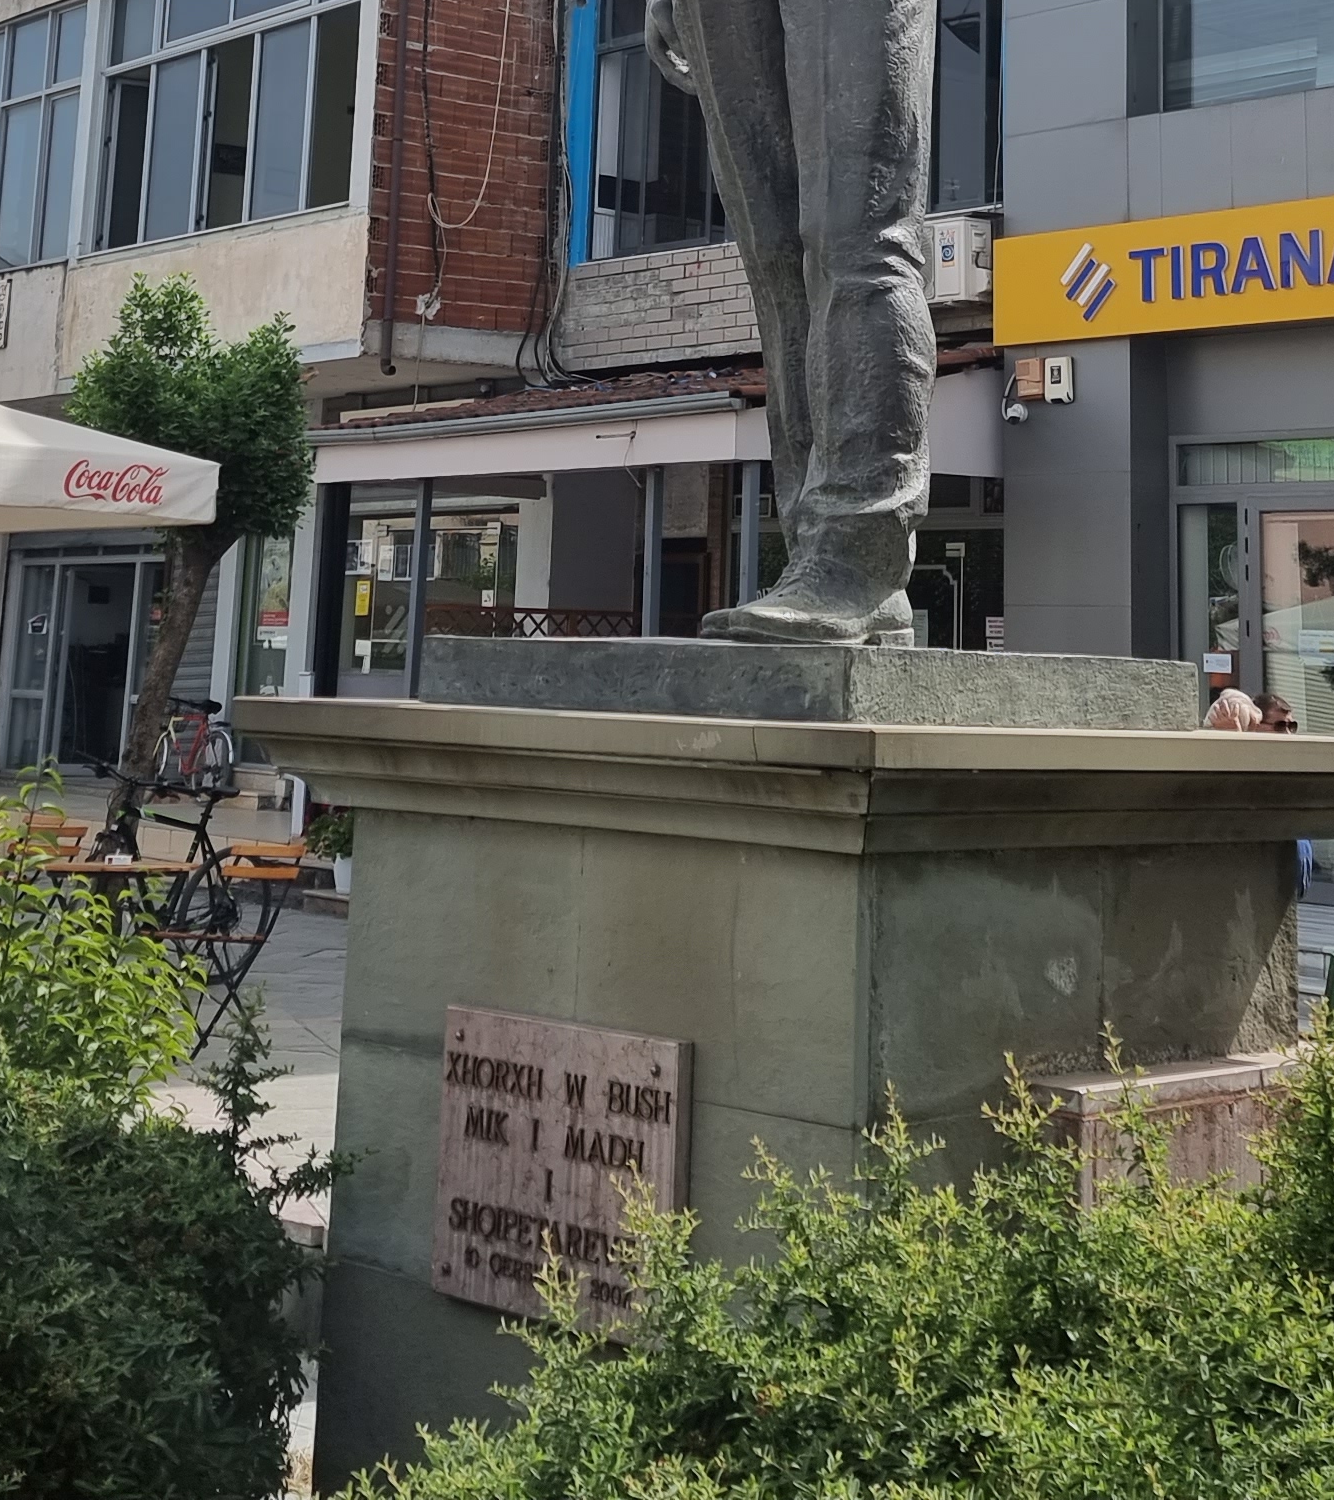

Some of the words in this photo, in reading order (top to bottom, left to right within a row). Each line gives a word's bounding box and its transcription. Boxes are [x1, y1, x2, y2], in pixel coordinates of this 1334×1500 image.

[63, 459, 170, 506] Coca-Cola
[446, 1051, 543, 1100] XHORXH
[565, 1071, 586, 1109] W
[607, 1080, 671, 1124] BUSH
[465, 1104, 509, 1146] MIK
[564, 1125, 645, 1174] MADH
